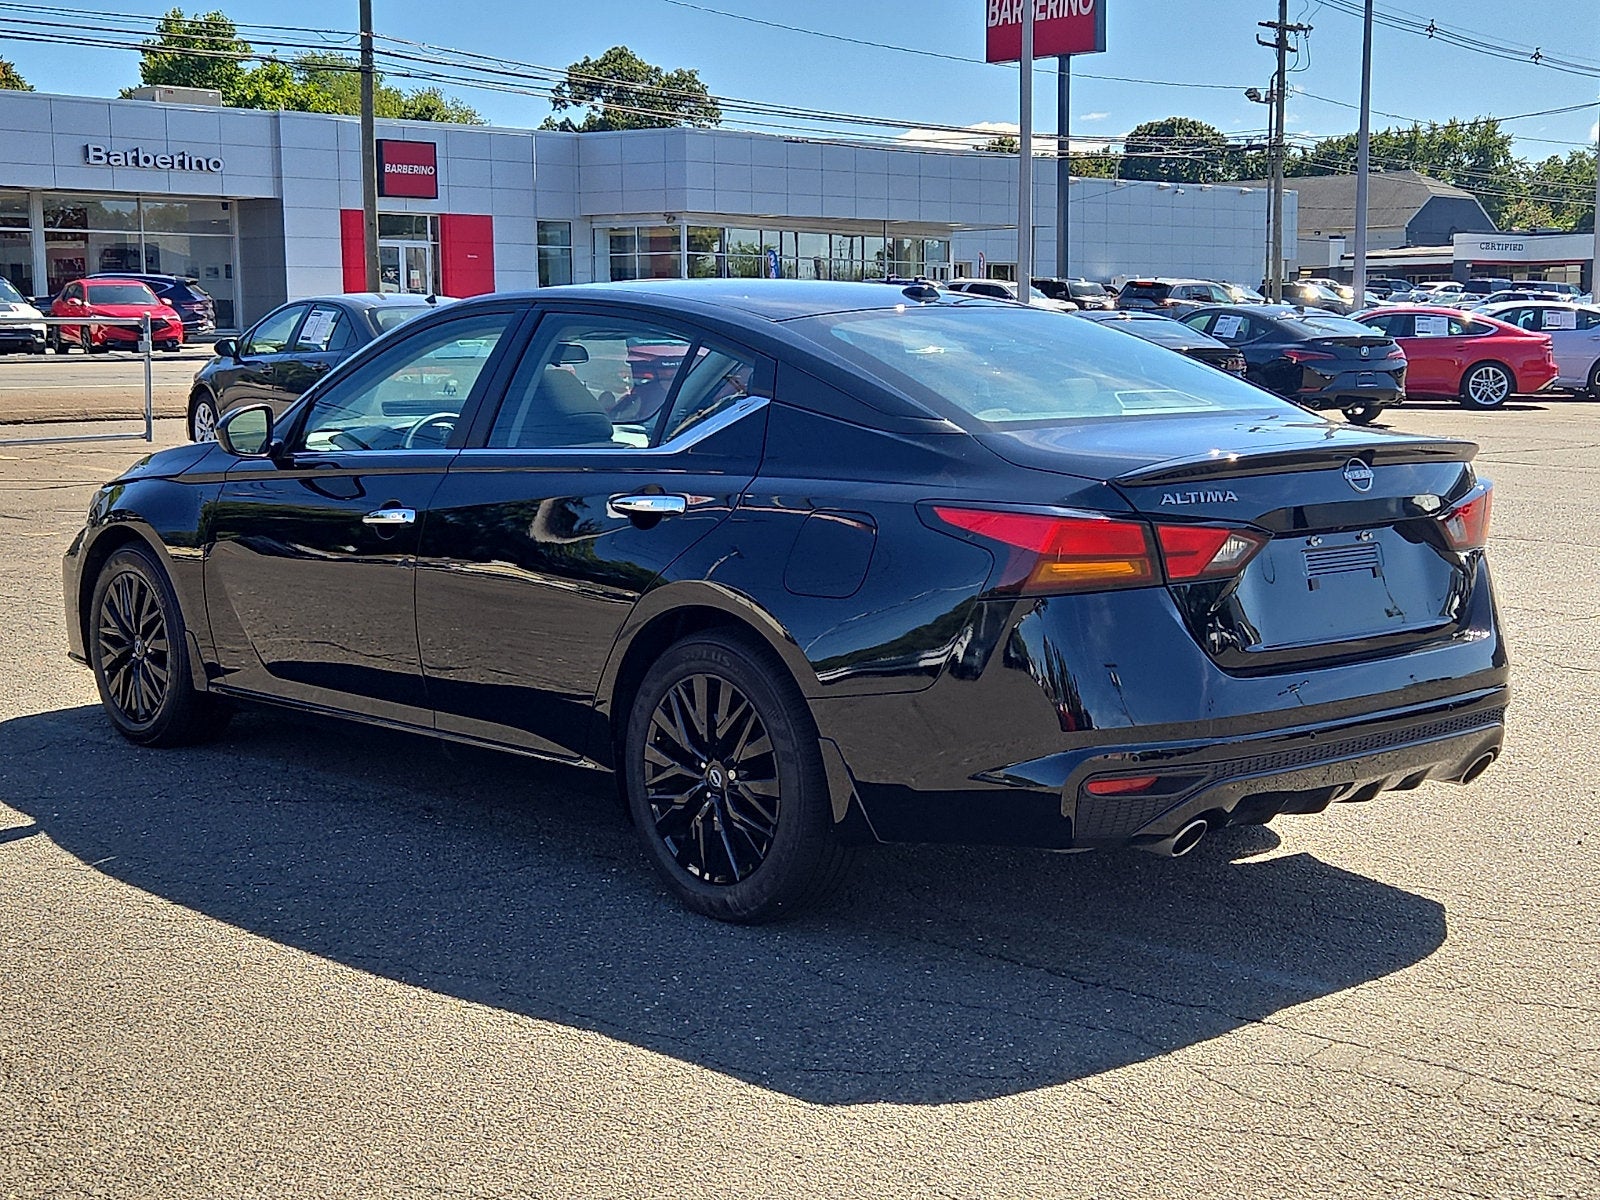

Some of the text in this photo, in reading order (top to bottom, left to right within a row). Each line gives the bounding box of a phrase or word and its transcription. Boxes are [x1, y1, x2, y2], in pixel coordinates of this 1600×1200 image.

[86, 143, 224, 172] Barberino
[384, 163, 435, 175] BARBERINO
[1479, 242, 1524, 251] CERTIFIED
[1160, 490, 1239, 506] ALTIMA
